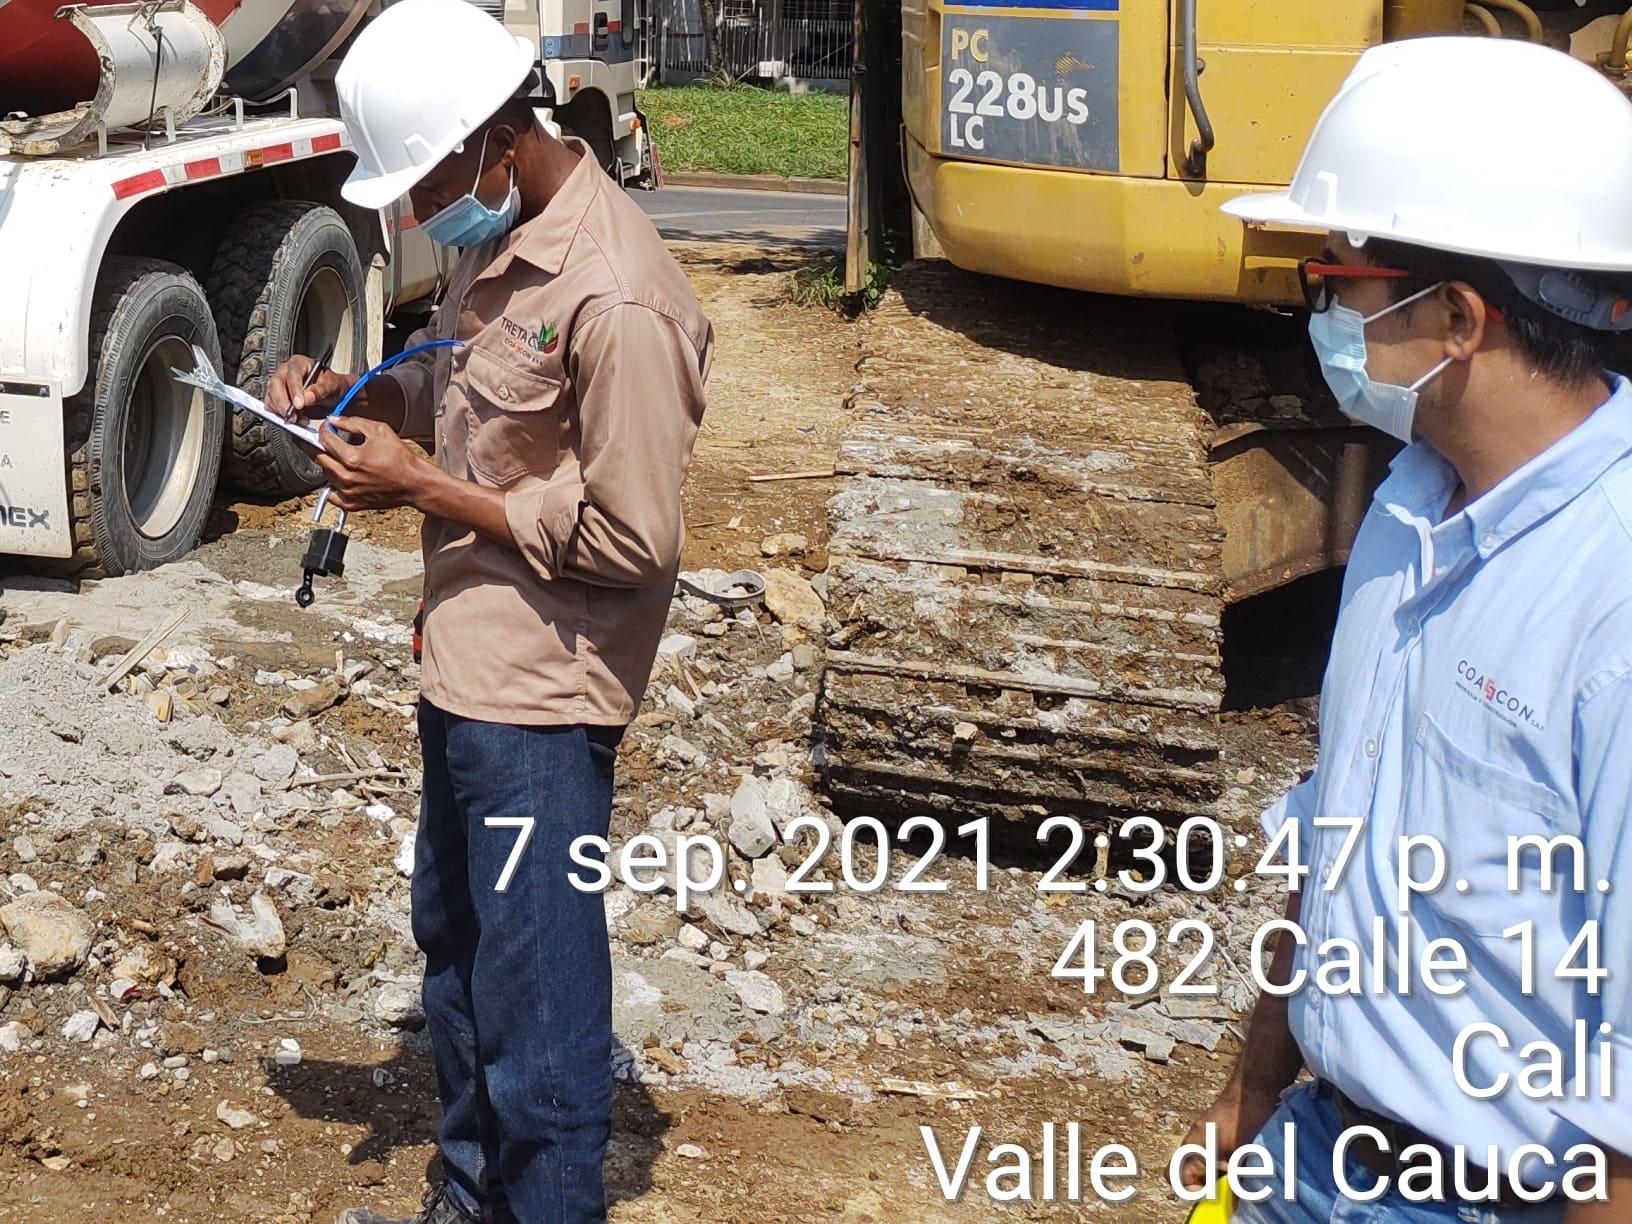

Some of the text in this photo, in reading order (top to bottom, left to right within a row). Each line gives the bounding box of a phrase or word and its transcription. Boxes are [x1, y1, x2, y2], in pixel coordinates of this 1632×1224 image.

[950, 27, 990, 63] PC
[948, 68, 1089, 125] 228US
[949, 113, 985, 151] LC
